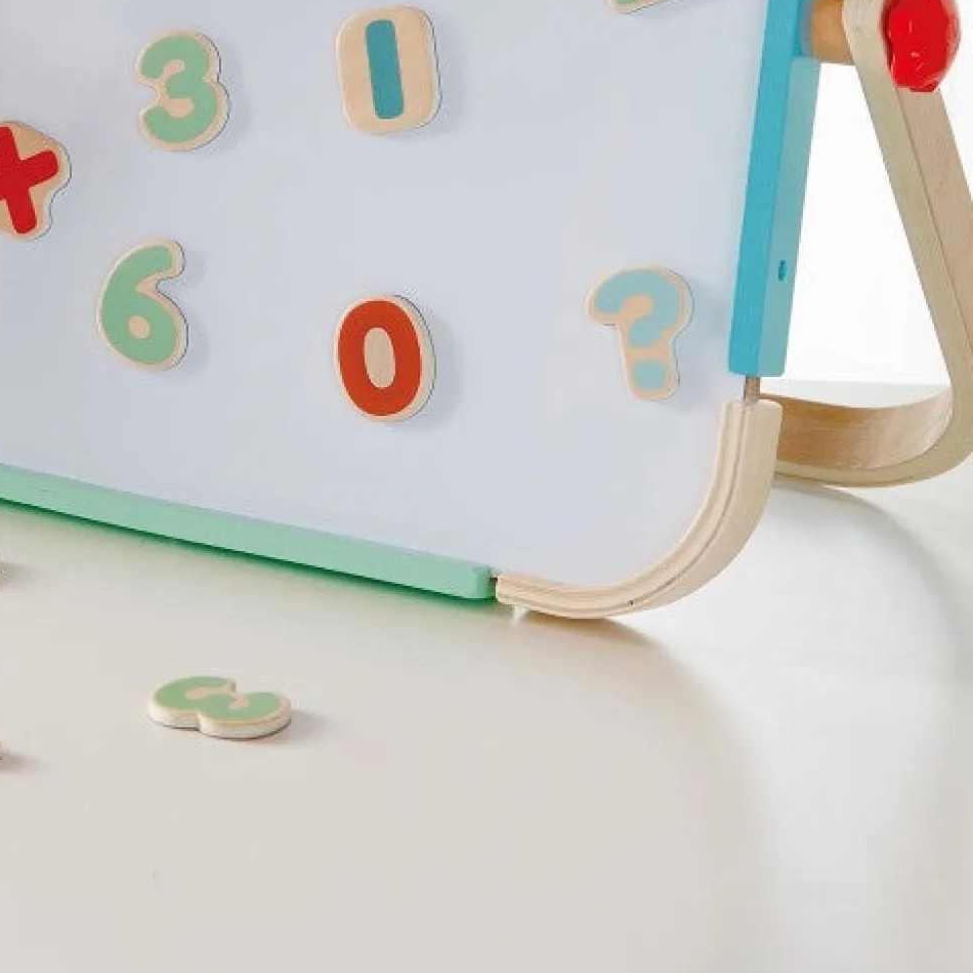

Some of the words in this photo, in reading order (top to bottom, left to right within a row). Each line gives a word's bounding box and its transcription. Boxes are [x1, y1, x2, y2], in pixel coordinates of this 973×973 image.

[139, 35, 218, 143] 3
[101, 245, 176, 365] 6
[338, 300, 422, 416] 0
